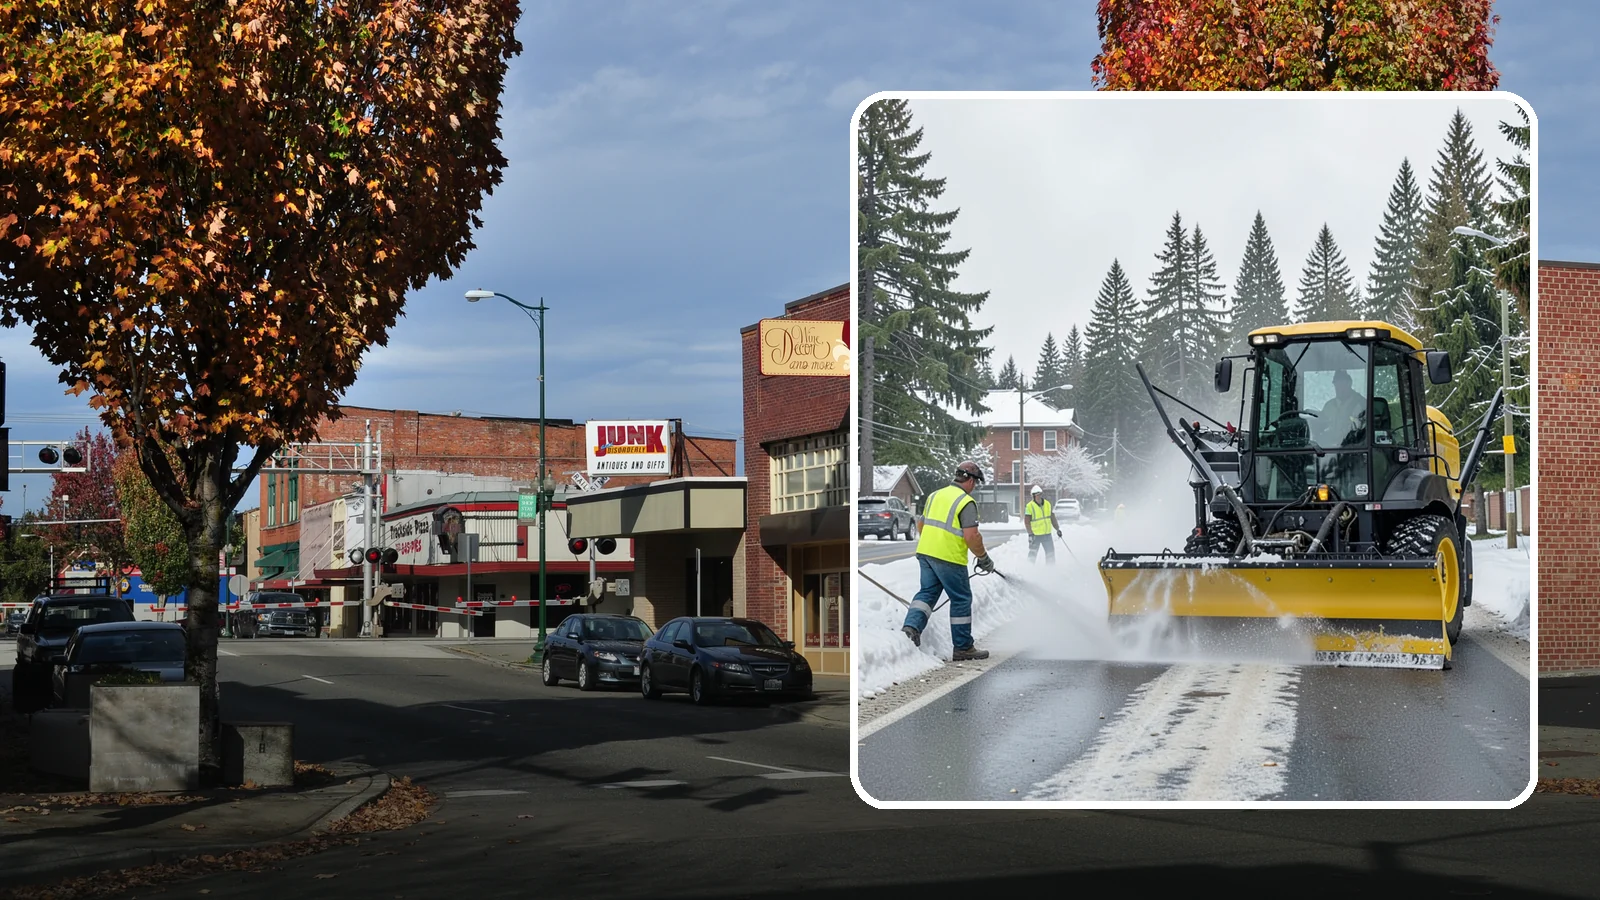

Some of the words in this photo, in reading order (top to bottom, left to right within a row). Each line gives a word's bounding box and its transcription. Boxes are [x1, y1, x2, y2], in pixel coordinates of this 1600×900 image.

[596, 425, 665, 457] JUNK
[597, 461, 628, 470] ANTIQUES
[631, 461, 644, 470] AND
[647, 460, 665, 470] GIFTS
[573, 473, 588, 491] RAIL
[352, 498, 365, 511] CRO
[414, 519, 429, 535] Pizza
